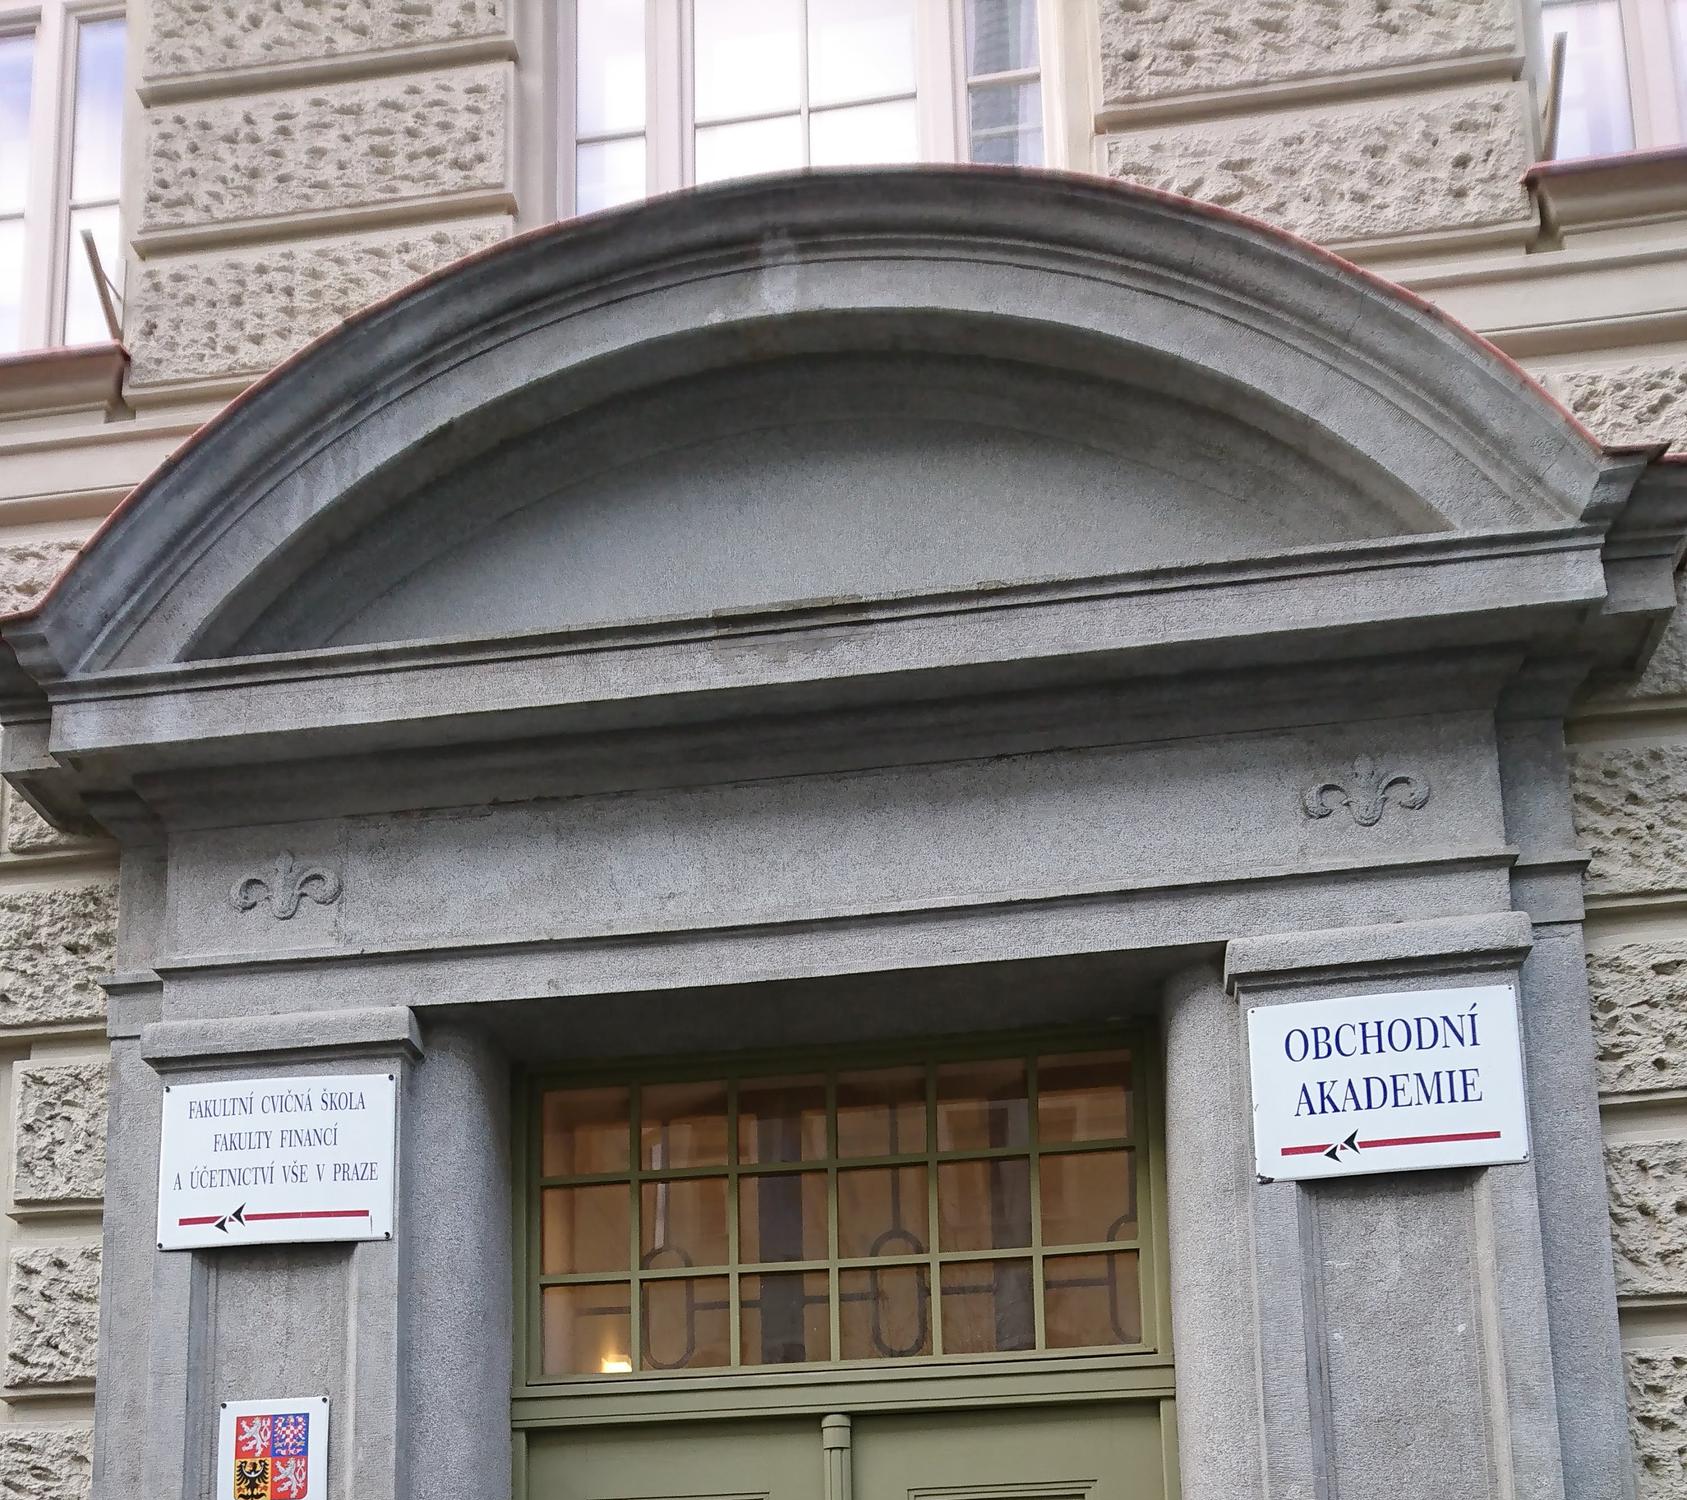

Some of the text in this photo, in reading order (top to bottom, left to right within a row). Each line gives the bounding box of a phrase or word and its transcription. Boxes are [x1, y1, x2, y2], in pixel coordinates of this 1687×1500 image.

[1284, 1002, 1481, 1062] OBCHODNÍ
[189, 1087, 366, 1120] FAKULTNÍ CVIČNÁ ŠKOLA
[1294, 1068, 1483, 1117] AKADEMIE
[213, 1122, 338, 1153] FAKULTY FINANCÍ
[173, 1159, 378, 1191] A ÚČETNICTVÍ VŠE V PRAZE
